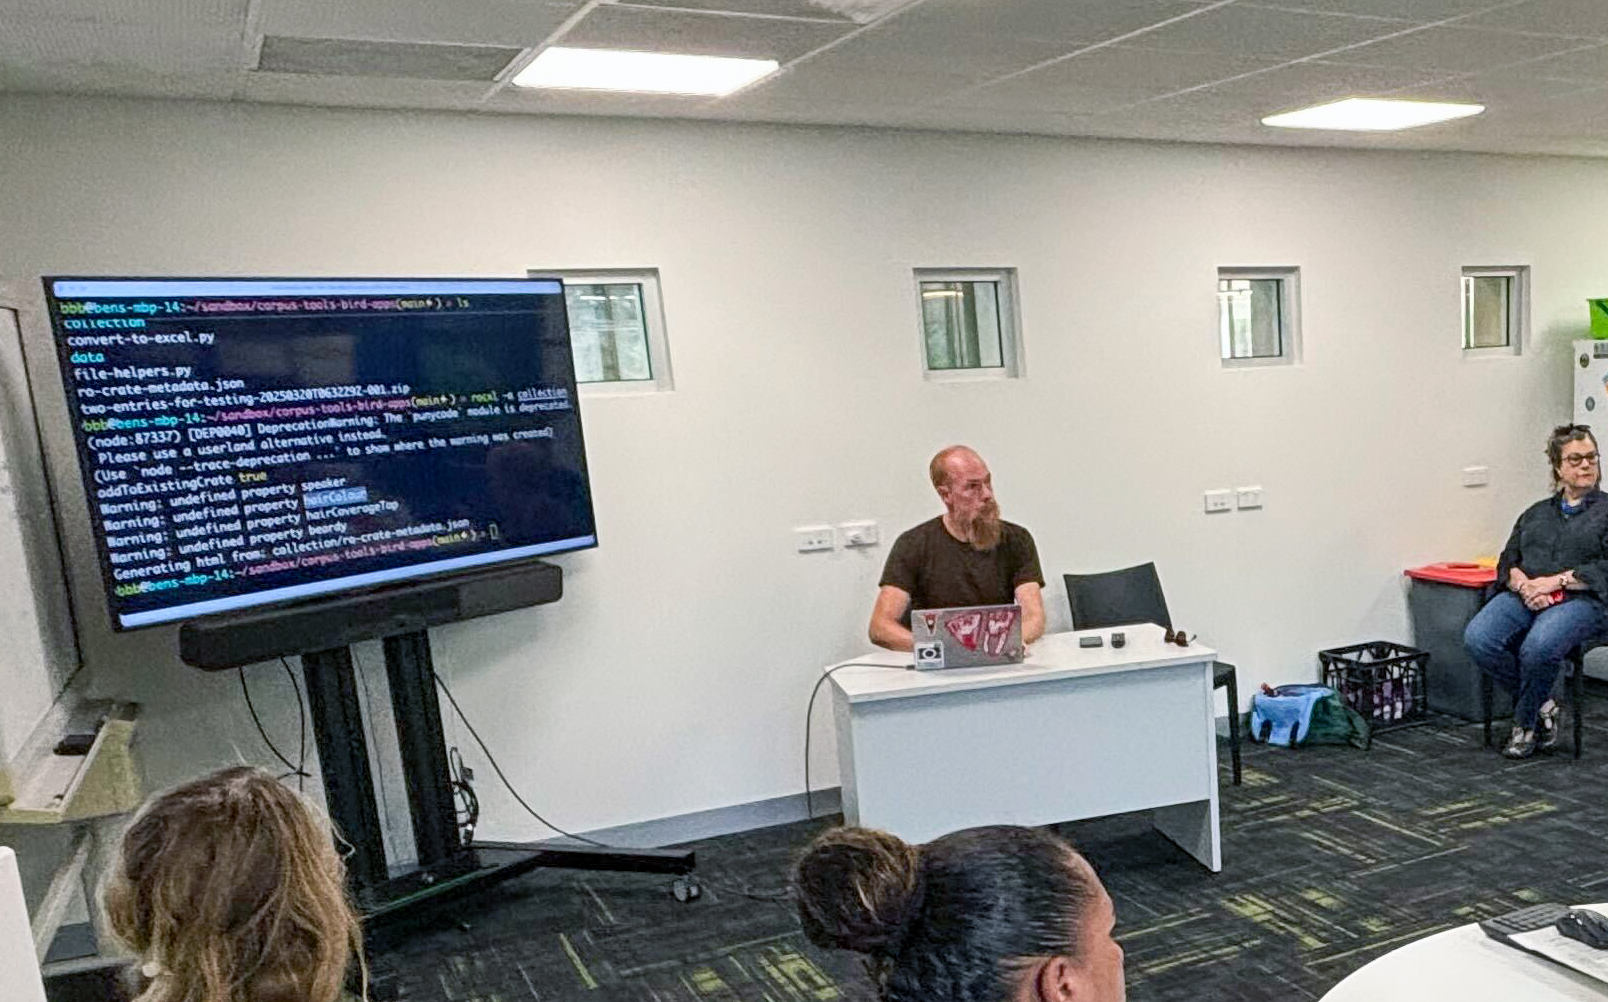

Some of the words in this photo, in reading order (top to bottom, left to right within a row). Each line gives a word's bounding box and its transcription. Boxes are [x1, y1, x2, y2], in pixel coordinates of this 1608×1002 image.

[64, 318, 145, 329] collection
[67, 330, 215, 346] convert-to-excel.py
[70, 352, 105, 363] data
[74, 366, 192, 381] file-helpers.py
[77, 378, 245, 398] ro-crate-metadata.json
[87, 430, 182, 450] (node:87337)
[383, 411, 403, 423] The
[94, 469, 127, 484] (Use
[179, 451, 311, 472] --trace-deprecation
[347, 445, 361, 456] to
[429, 437, 446, 448] the
[98, 451, 147, 464] Please
[153, 449, 178, 460] use
[183, 447, 192, 457] a
[198, 440, 255, 456] userland
[260, 433, 334, 450] alternative
[97, 474, 233, 499] addToExistingCrate
[239, 471, 268, 482] true
[170, 488, 236, 507] undefined
[241, 483, 296, 500] property
[300, 476, 346, 491] speaker
[173, 504, 239, 523] undefined
[244, 498, 298, 515] property
[175, 520, 242, 539] undefined
[246, 513, 300, 531] property
[305, 500, 399, 520] hairCoverageTop
[178, 535, 245, 554] undefined
[249, 528, 303, 547] property
[308, 520, 347, 536] beardy
[113, 560, 191, 580] Generating
[196, 552, 226, 568] html
